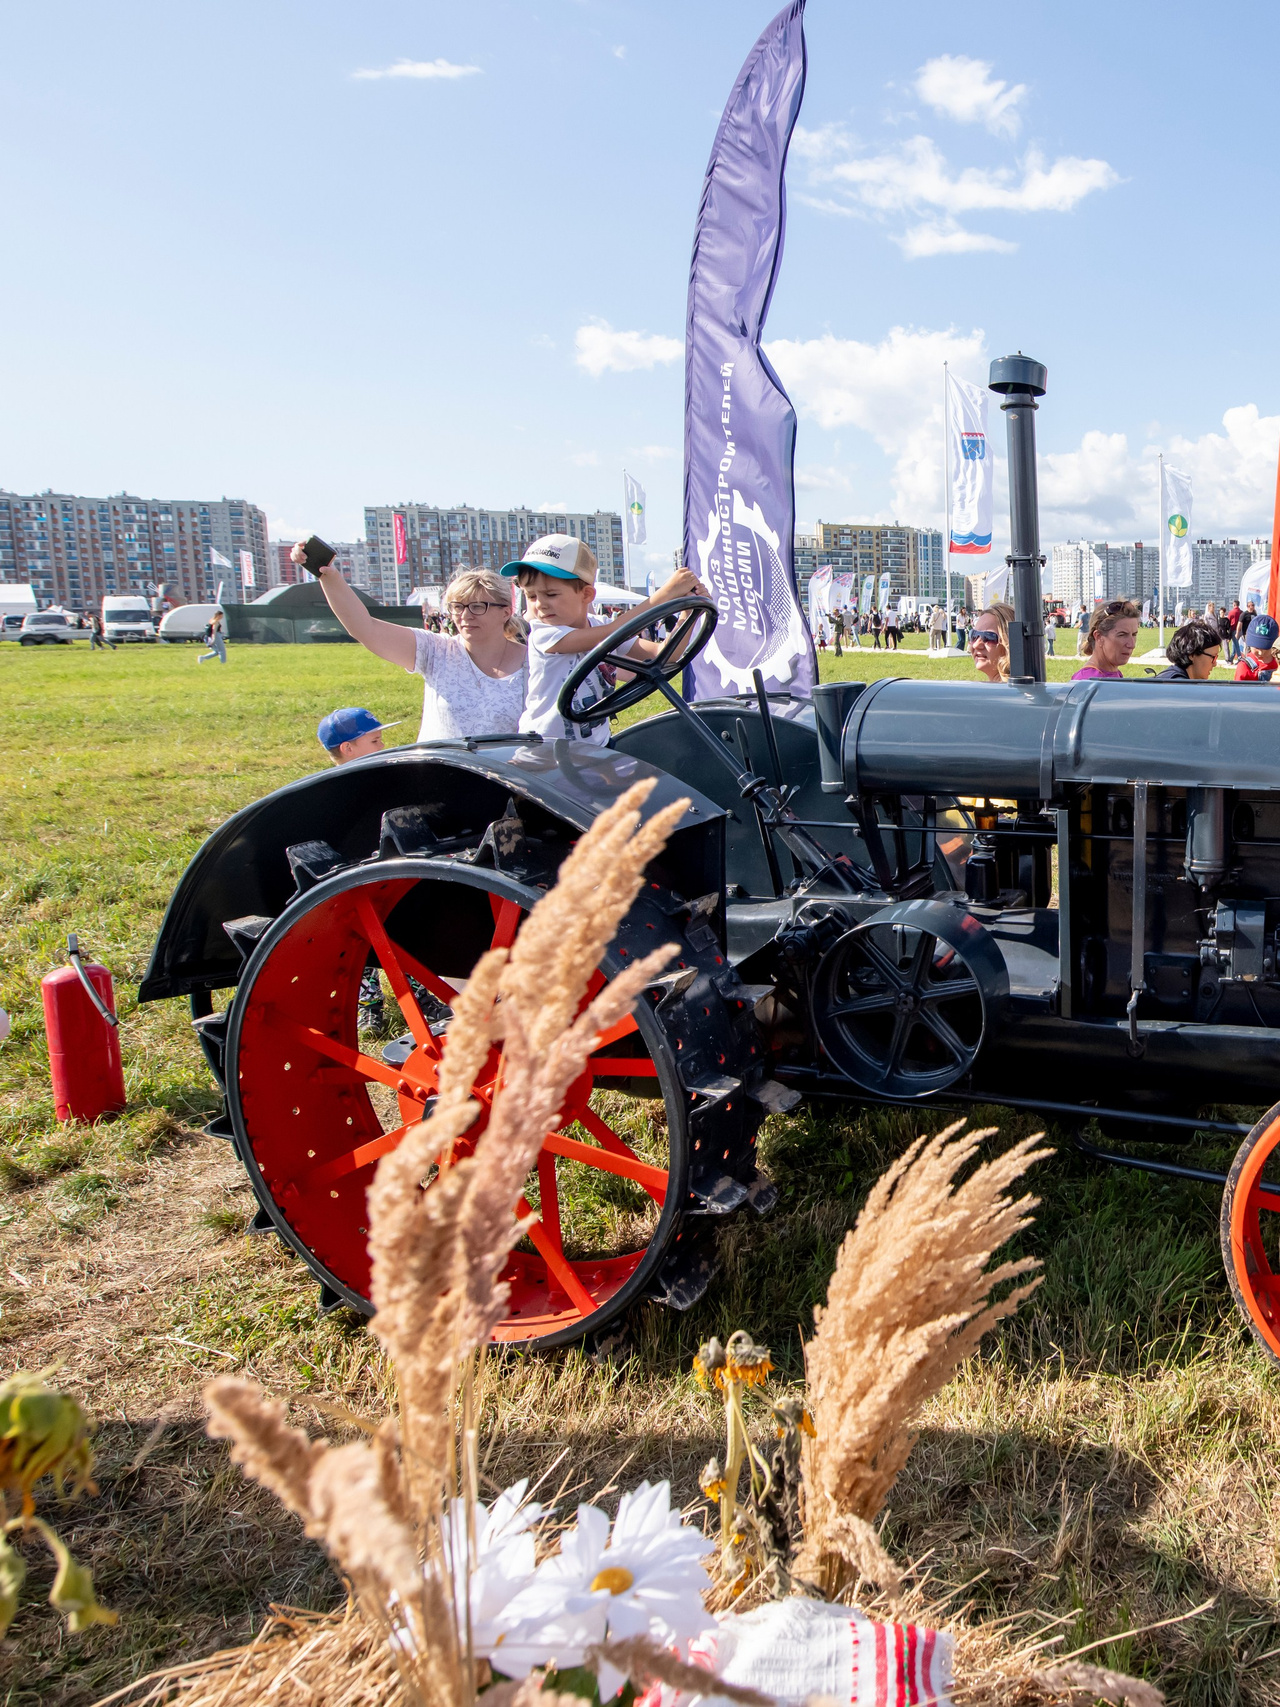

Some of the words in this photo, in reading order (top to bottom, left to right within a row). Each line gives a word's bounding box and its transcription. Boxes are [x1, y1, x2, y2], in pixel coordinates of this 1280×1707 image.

[717, 362, 747, 631] МАШИНОСТРОИТЕЛЕЙ
[711, 559, 731, 625] СОЮЗ
[737, 541, 763, 636] РОССИИ
